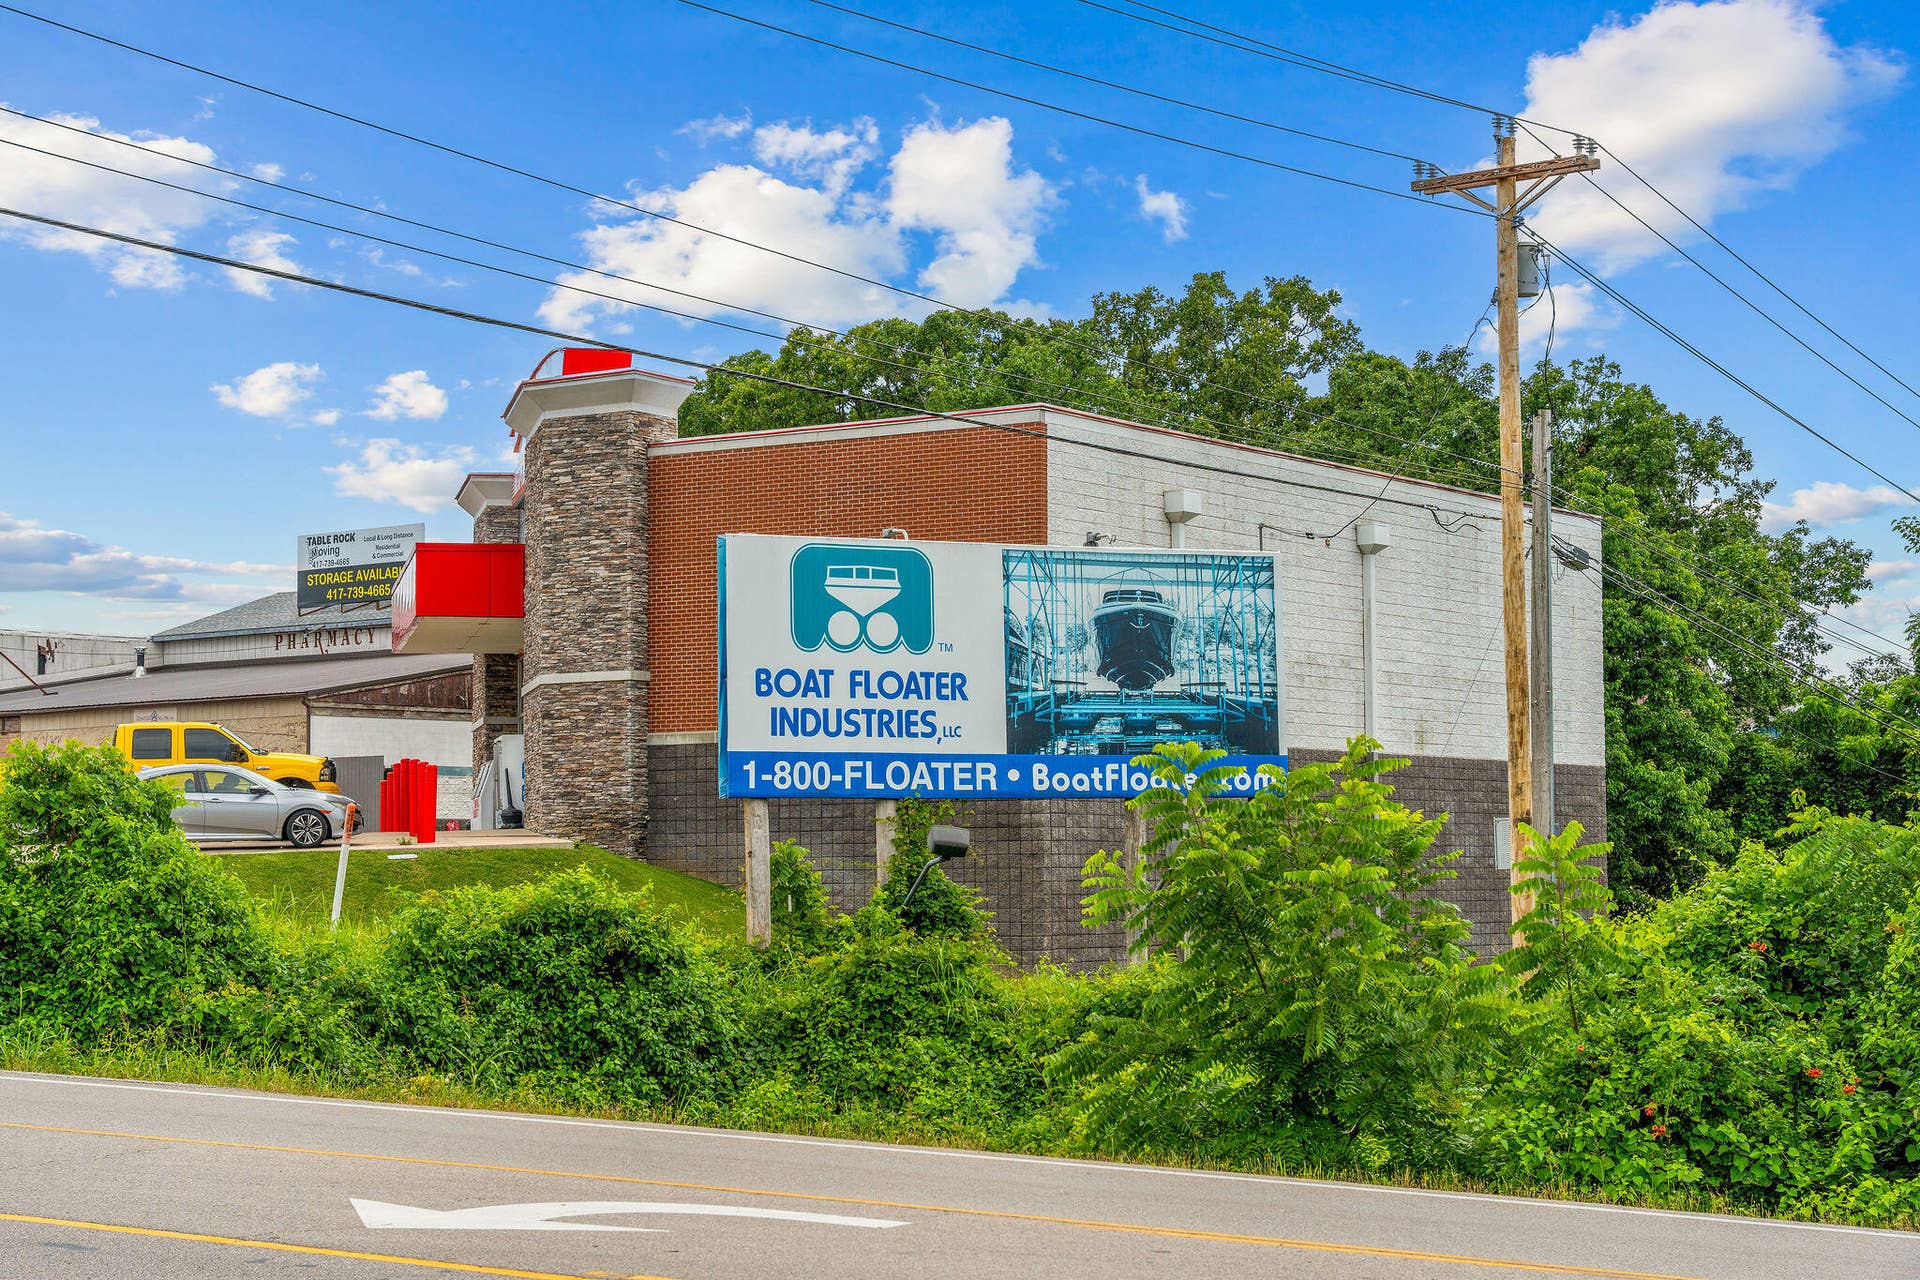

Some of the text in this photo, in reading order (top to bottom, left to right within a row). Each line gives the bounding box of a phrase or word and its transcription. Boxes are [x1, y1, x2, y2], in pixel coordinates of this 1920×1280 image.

[306, 532, 356, 546] TABLE ROCK
[381, 533, 393, 541] Long
[311, 545, 340, 557] Moving
[311, 557, 350, 568] 417-739-4665
[307, 566, 404, 586] STORAGE AVAILAB
[326, 583, 391, 601] 417-739-4665
[274, 626, 375, 654] PHARMACY
[937, 642, 953, 652] TM
[755, 667, 969, 701] BOAT FLOATER
[770, 706, 962, 744] INDUSTRIES, LLC
[743, 759, 997, 791] 1-800-FLOATER
